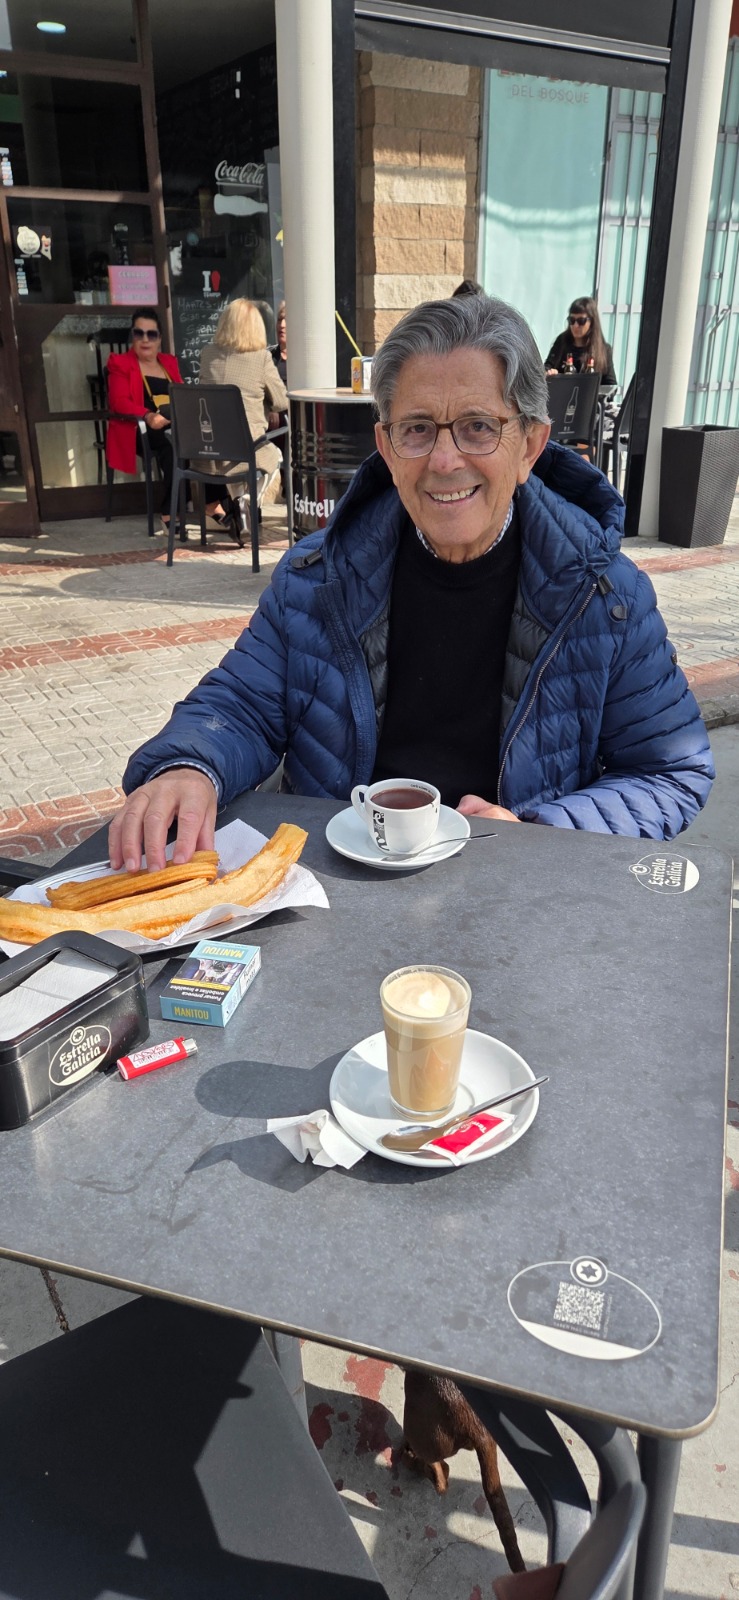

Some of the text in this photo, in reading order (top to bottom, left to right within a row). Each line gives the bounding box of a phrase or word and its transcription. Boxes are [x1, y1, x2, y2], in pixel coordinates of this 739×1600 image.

[511, 84, 590, 104] DEL BOSQUE
[215, 160, 265, 184] Coca-Cola
[294, 493, 335, 519] Estrell
[648, 858, 667, 886] Estrella
[664, 861, 683, 887] Galicia
[202, 946, 244, 958] MANITOU
[174, 1006, 209, 1020] MANITOU
[59, 1033, 101, 1067] Estrella
[61, 1046, 101, 1076] Galicia
